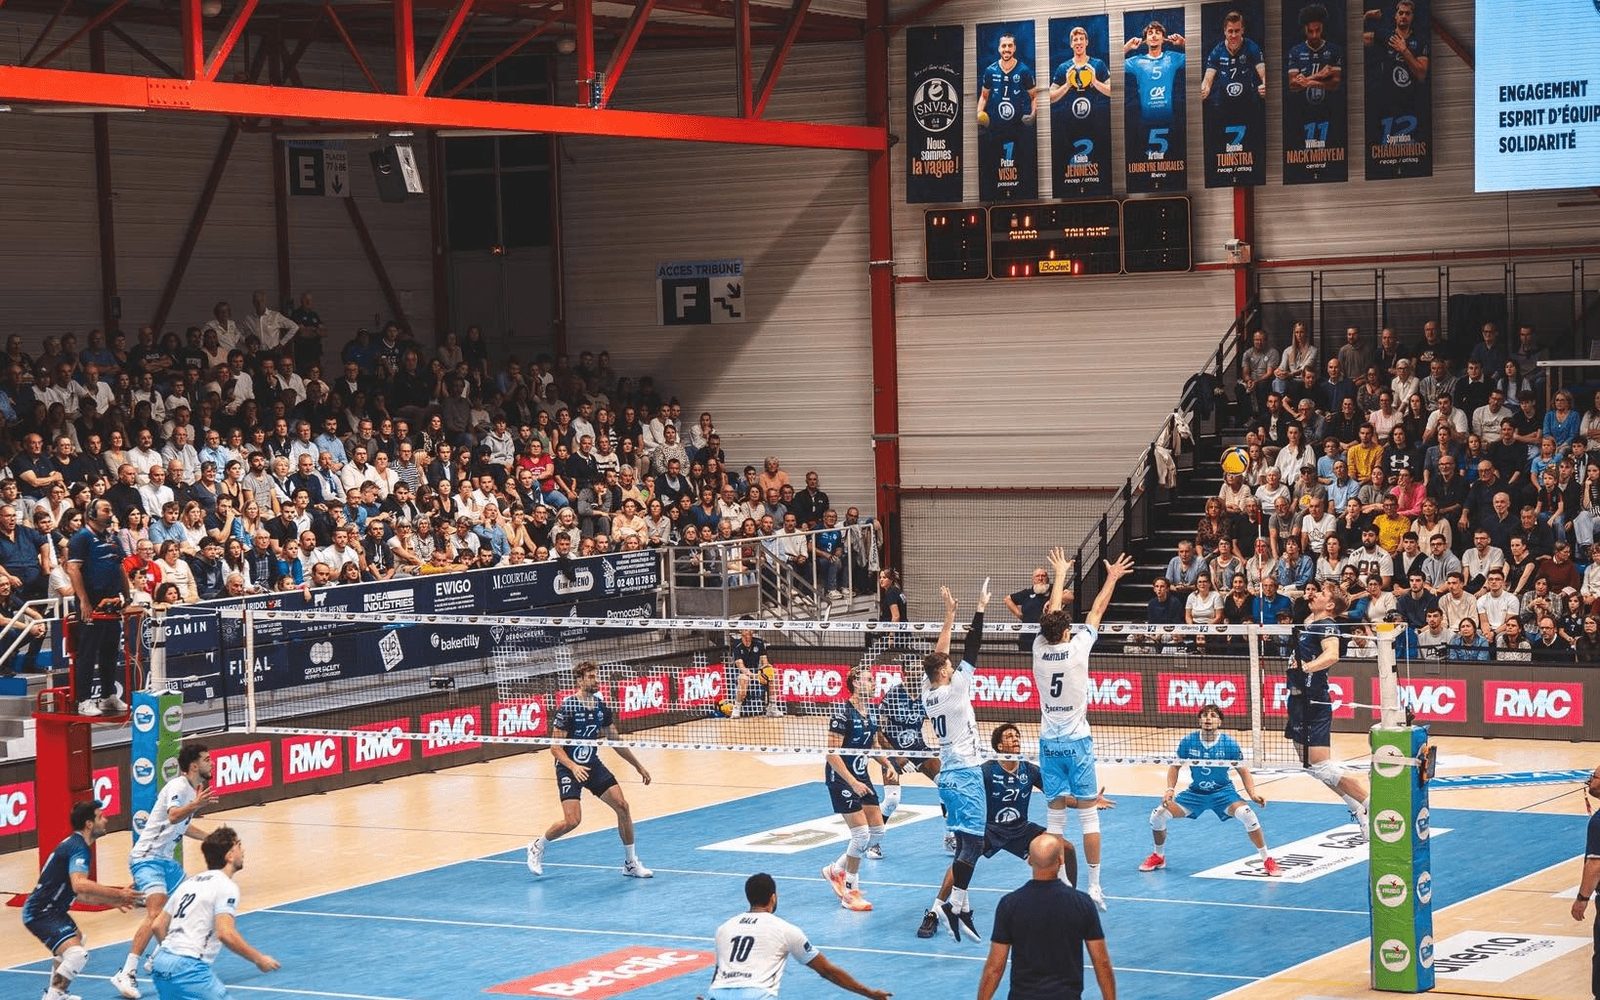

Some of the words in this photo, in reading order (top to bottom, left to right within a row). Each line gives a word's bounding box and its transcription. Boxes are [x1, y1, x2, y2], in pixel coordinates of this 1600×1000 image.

[1151, 66, 1162, 80] 5
[1499, 80, 1588, 102] ENGAGEMENT
[916, 101, 954, 115] SNVBA
[1499, 109, 1545, 128] ESPRIT
[1225, 125, 1247, 144] 7
[1304, 121, 1329, 141] 11
[1381, 115, 1418, 144] 12
[926, 137, 946, 150] Nous
[1003, 141, 1015, 160] 1
[1146, 128, 1169, 155] 5
[1371, 142, 1427, 159] CHANDRINOS
[1499, 129, 1576, 154] SOLIDARITÉ
[920, 149, 952, 161] sommes
[1069, 139, 1094, 164] 2
[1216, 152, 1254, 167] TUINSTRA
[298, 155, 316, 188] E
[912, 157, 923, 175] la
[923, 159, 955, 178] vague
[1000, 158, 1015, 167] Petar
[1064, 163, 1099, 178] JENNESS
[998, 167, 1018, 181] VISIC
[658, 265, 693, 276] ACCES
[694, 263, 741, 274] TRIBUNE
[1040, 262, 1070, 272] Bodet
[675, 286, 697, 318] F
[826, 542, 833, 552] 3
[502, 570, 538, 585] COURTAGE
[616, 578, 625, 588] 02
[625, 577, 635, 587] 40
[635, 577, 641, 586] 11
[641, 576, 649, 585] 78
[649, 574, 657, 584] 51
[367, 591, 389, 602] IDEA
[435, 579, 472, 596] EWIGO
[364, 597, 414, 612] INDUSTRIES
[607, 606, 644, 618] Promocash
[441, 634, 480, 651] bakertilly
[229, 656, 271, 675] FIAL
[684, 671, 721, 698] RMC
[783, 669, 842, 696] RMC
[969, 674, 1032, 702] RMC
[1050, 672, 1064, 698] 5
[1087, 677, 1130, 705] MC
[625, 680, 664, 712] RMC
[1167, 679, 1237, 709] RMC
[1398, 685, 1455, 714] MC
[1494, 687, 1572, 718] RMC
[498, 701, 541, 736] RMC
[428, 714, 475, 749] RMC
[582, 724, 597, 737] 17
[863, 731, 871, 745] 7
[355, 727, 403, 762] RMC
[289, 738, 337, 774] RMC
[215, 749, 265, 787] RMC
[562, 784, 571, 794] 17
[1002, 788, 1020, 802] 21
[845, 799, 853, 809] 7
[173, 893, 196, 918] 32
[729, 935, 755, 963] 10
[530, 951, 701, 998] Betclic
